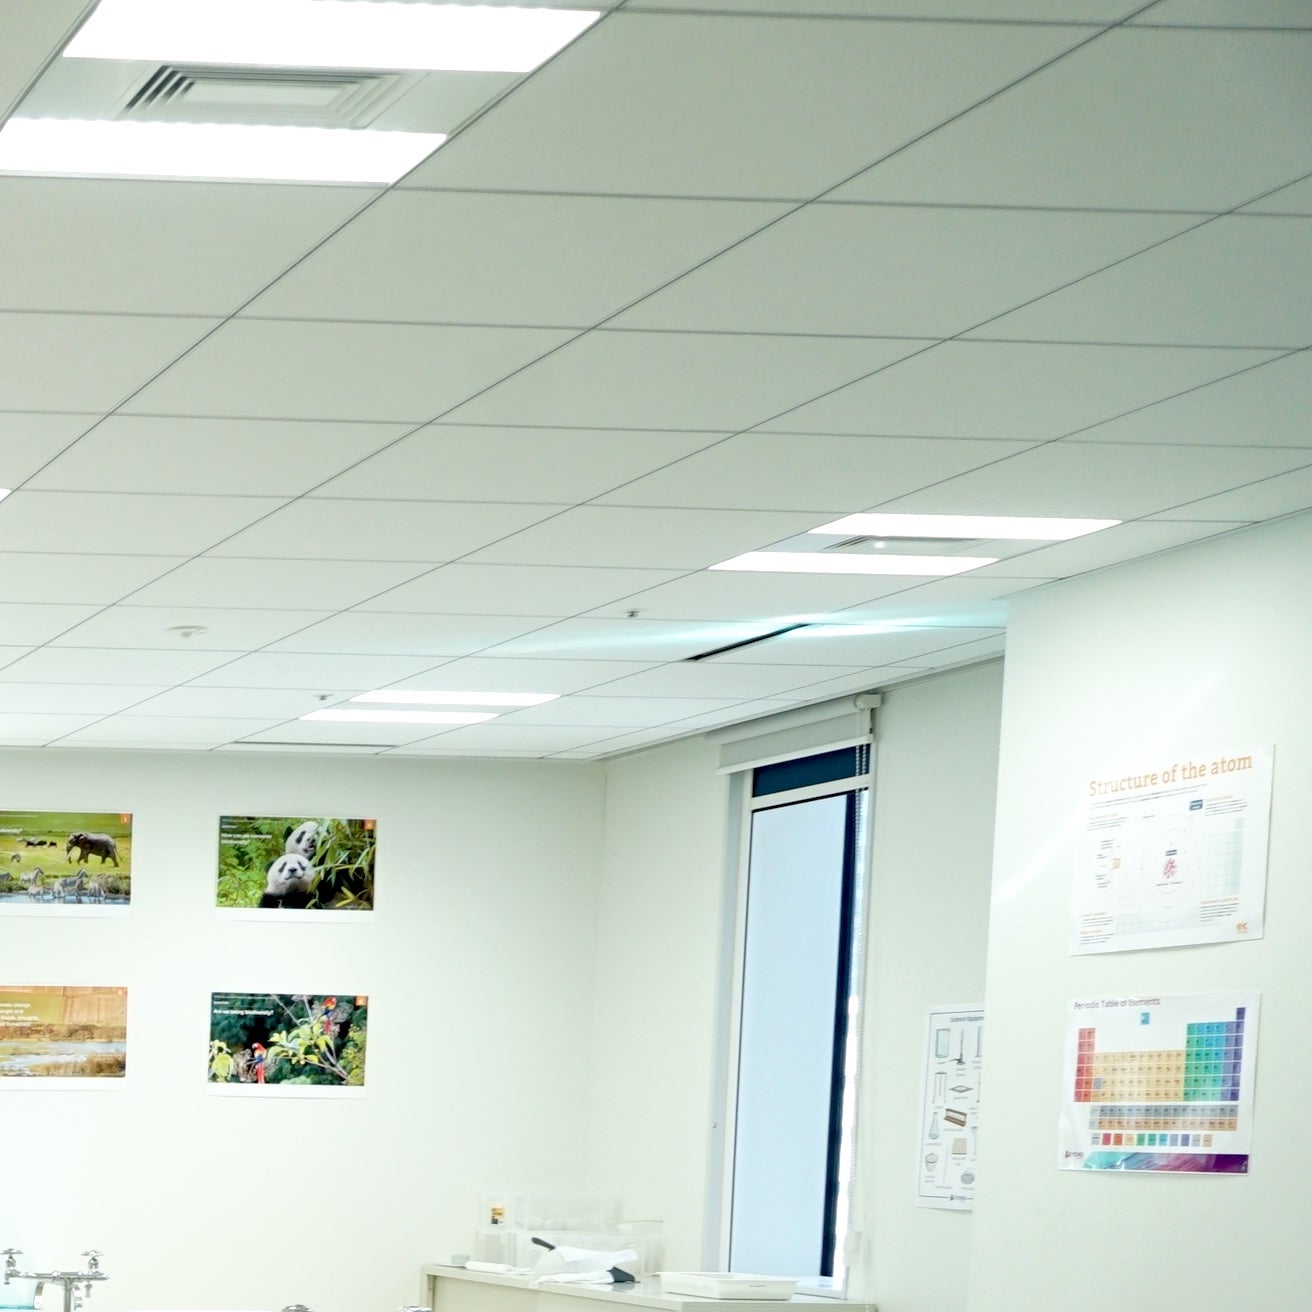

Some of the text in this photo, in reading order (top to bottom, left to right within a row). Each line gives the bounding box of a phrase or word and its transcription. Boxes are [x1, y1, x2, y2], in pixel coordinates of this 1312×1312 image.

[1088, 772, 1158, 797] Structure
[1162, 764, 1178, 783] of
[1182, 762, 1206, 780] the
[1210, 755, 1252, 775] atom
